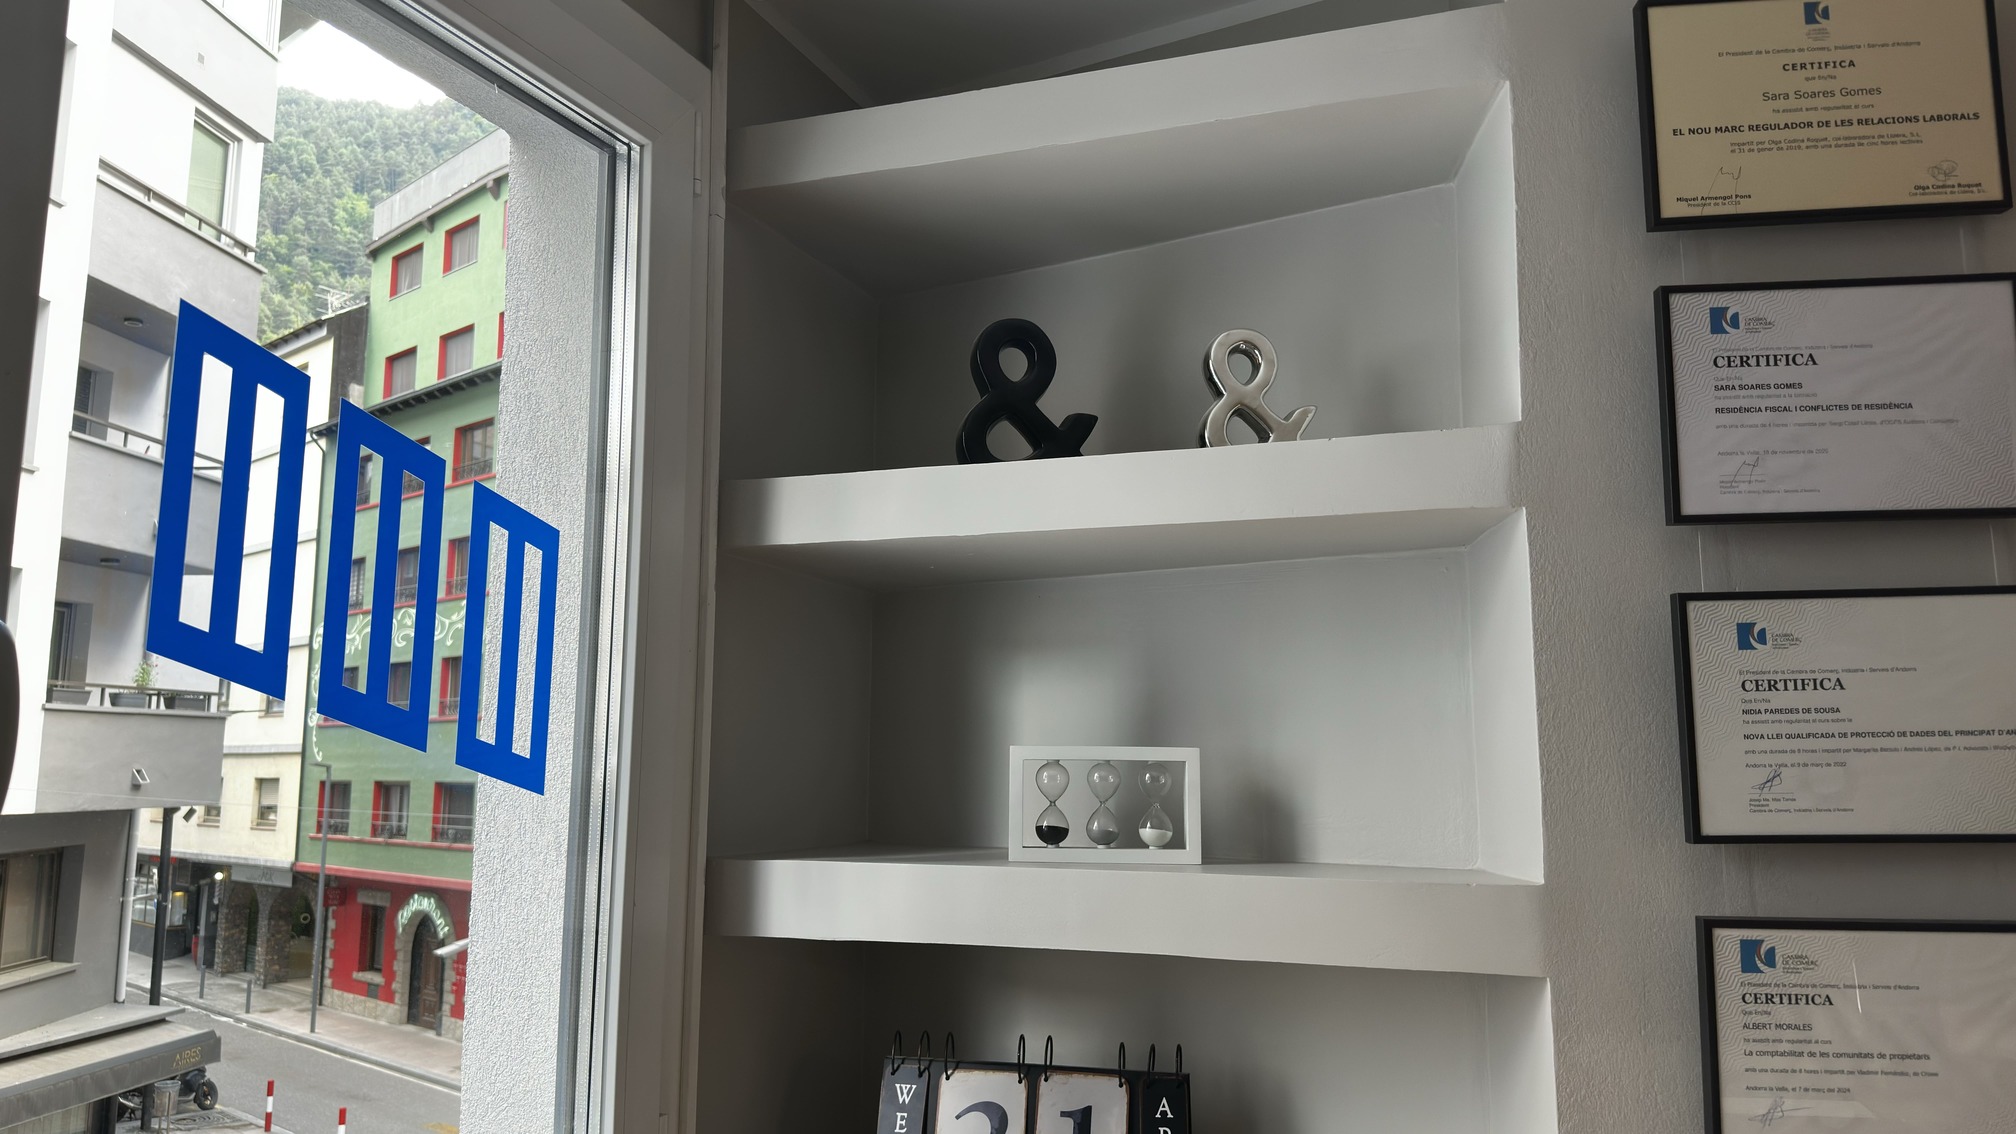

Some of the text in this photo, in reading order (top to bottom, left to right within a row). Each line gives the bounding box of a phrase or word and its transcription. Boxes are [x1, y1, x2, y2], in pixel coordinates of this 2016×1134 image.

[1782, 59, 1856, 71] CERTIFICA
[1762, 86, 1881, 102] Sara Soares Gomes
[1672, 112, 1980, 136] EL NOU MARC REGULADOR DE LES RELACIONS LABORALS
[1700, 194, 1733, 202] Armengol
[1713, 353, 1818, 369] CERTIFICA
[1714, 382, 1803, 392] SARA SOARES GOMES
[1715, 406, 1763, 414] RESIDÈNCIA
[1799, 404, 1849, 412] CONFLICTES
[1864, 402, 1913, 410] RESIDÈNCIA
[1741, 677, 1845, 692] CERTIFICA
[1813, 706, 1841, 714] SOUSA
[1785, 732, 1836, 740] QUALIFICADA
[1850, 730, 1895, 738] PROTECCIÓ
[1955, 729, 1996, 737] PRINCIPAT
[1742, 992, 1834, 1006] CERTIFICA
[1775, 1023, 1813, 1031] MORALES
[173, 1046, 203, 1068] AIRES
[1744, 1049, 1753, 1057] La
[1755, 1050, 1804, 1059] comptabilitat
